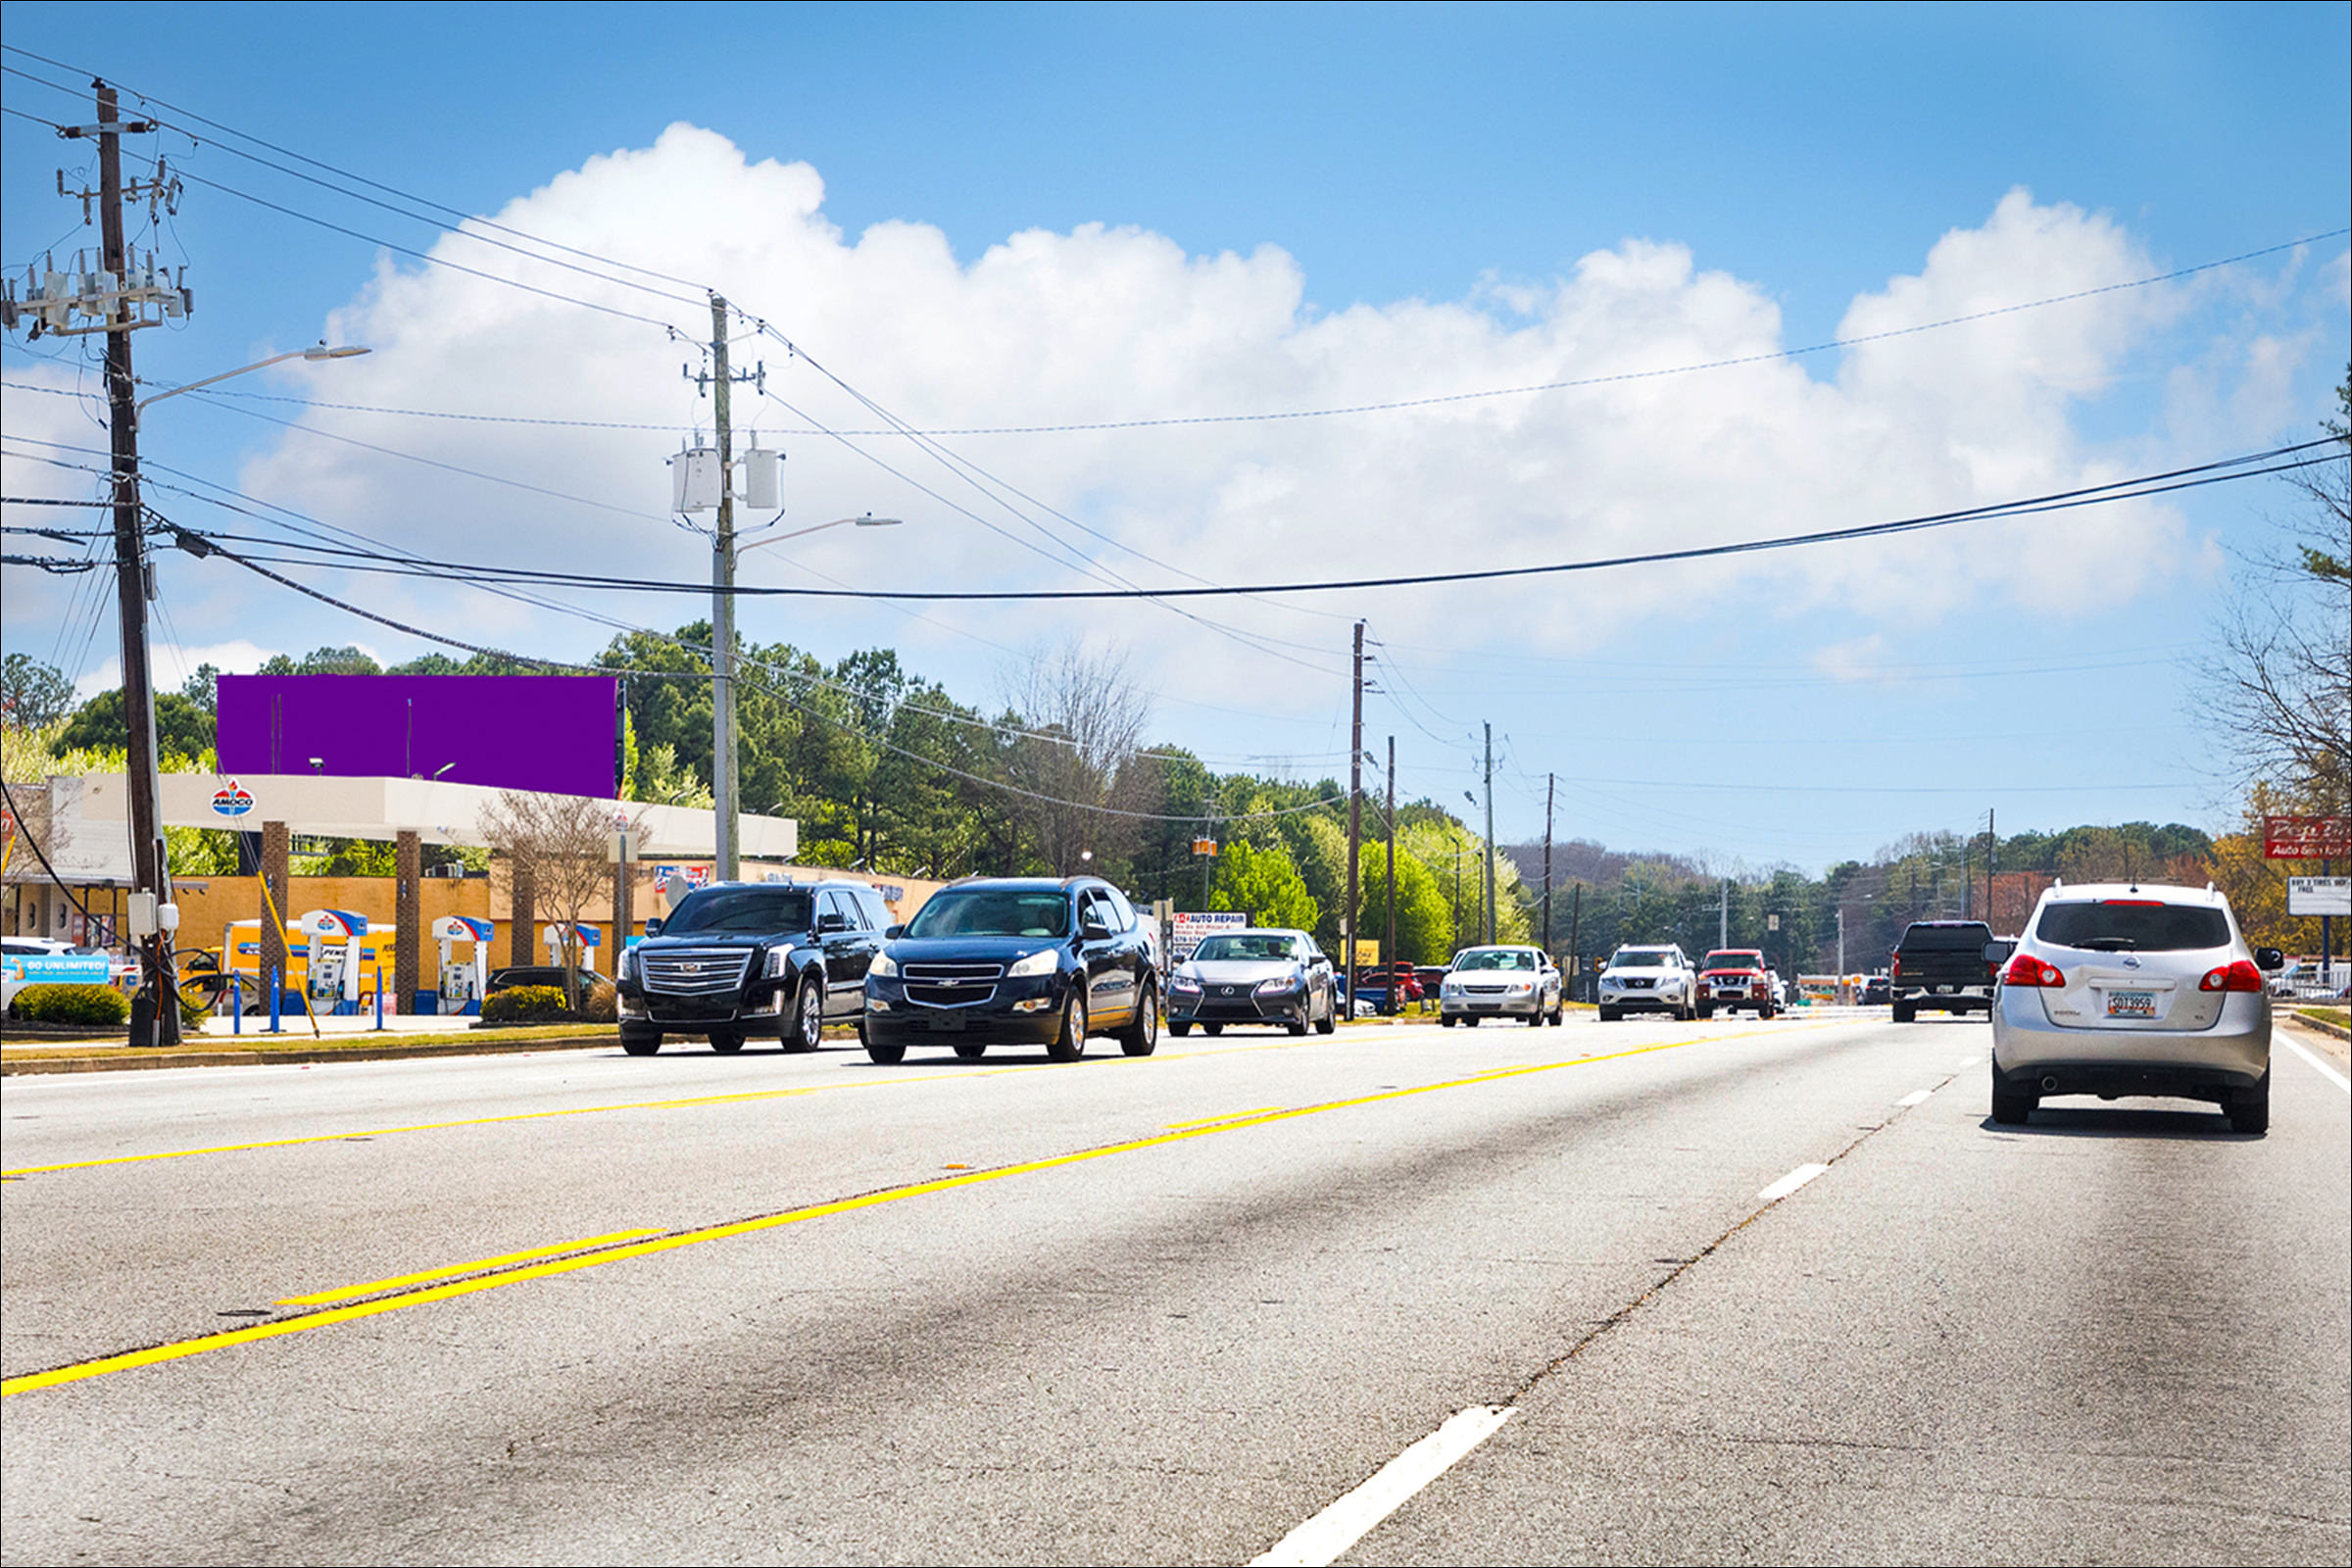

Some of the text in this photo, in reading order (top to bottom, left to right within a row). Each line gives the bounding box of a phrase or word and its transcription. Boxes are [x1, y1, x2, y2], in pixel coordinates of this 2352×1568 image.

[213, 798, 254, 807] AMOCO
[2272, 845, 2299, 856] Auto
[1190, 914, 1213, 923] AUTO
[1214, 914, 1245, 923] REPAIR
[26, 960, 106, 971] GO UNLIMITED!
